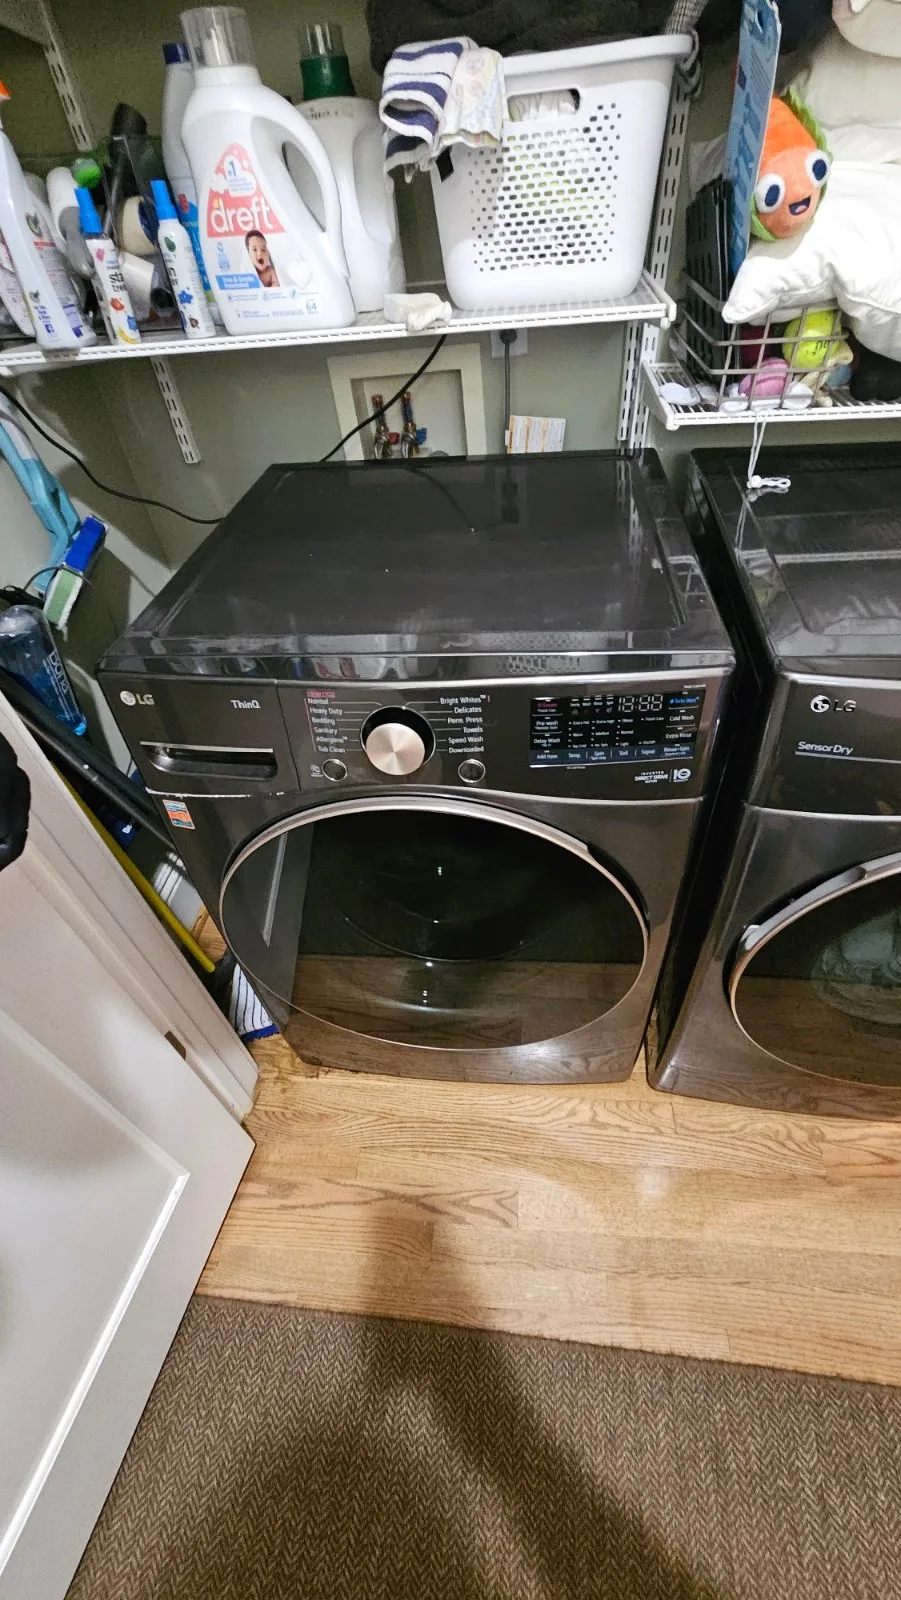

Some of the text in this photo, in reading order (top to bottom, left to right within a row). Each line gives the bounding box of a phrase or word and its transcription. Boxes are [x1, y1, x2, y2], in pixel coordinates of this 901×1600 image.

[211, 196, 273, 233] dreft
[306, 302, 317, 311] 64
[135, 694, 155, 705] LG
[230, 699, 261, 709] ThinQ
[441, 697, 459, 706] Bright
[454, 706, 482, 714] Delicates
[834, 700, 857, 712] LG
[328, 707, 343, 716] Duty
[312, 717, 336, 726] Bedding
[314, 727, 338, 735] Sanitary
[449, 737, 467, 745] Speed
[329, 746, 346, 754] Clean
[448, 746, 485, 754] Downloaded
[673, 768, 691, 780] 10
